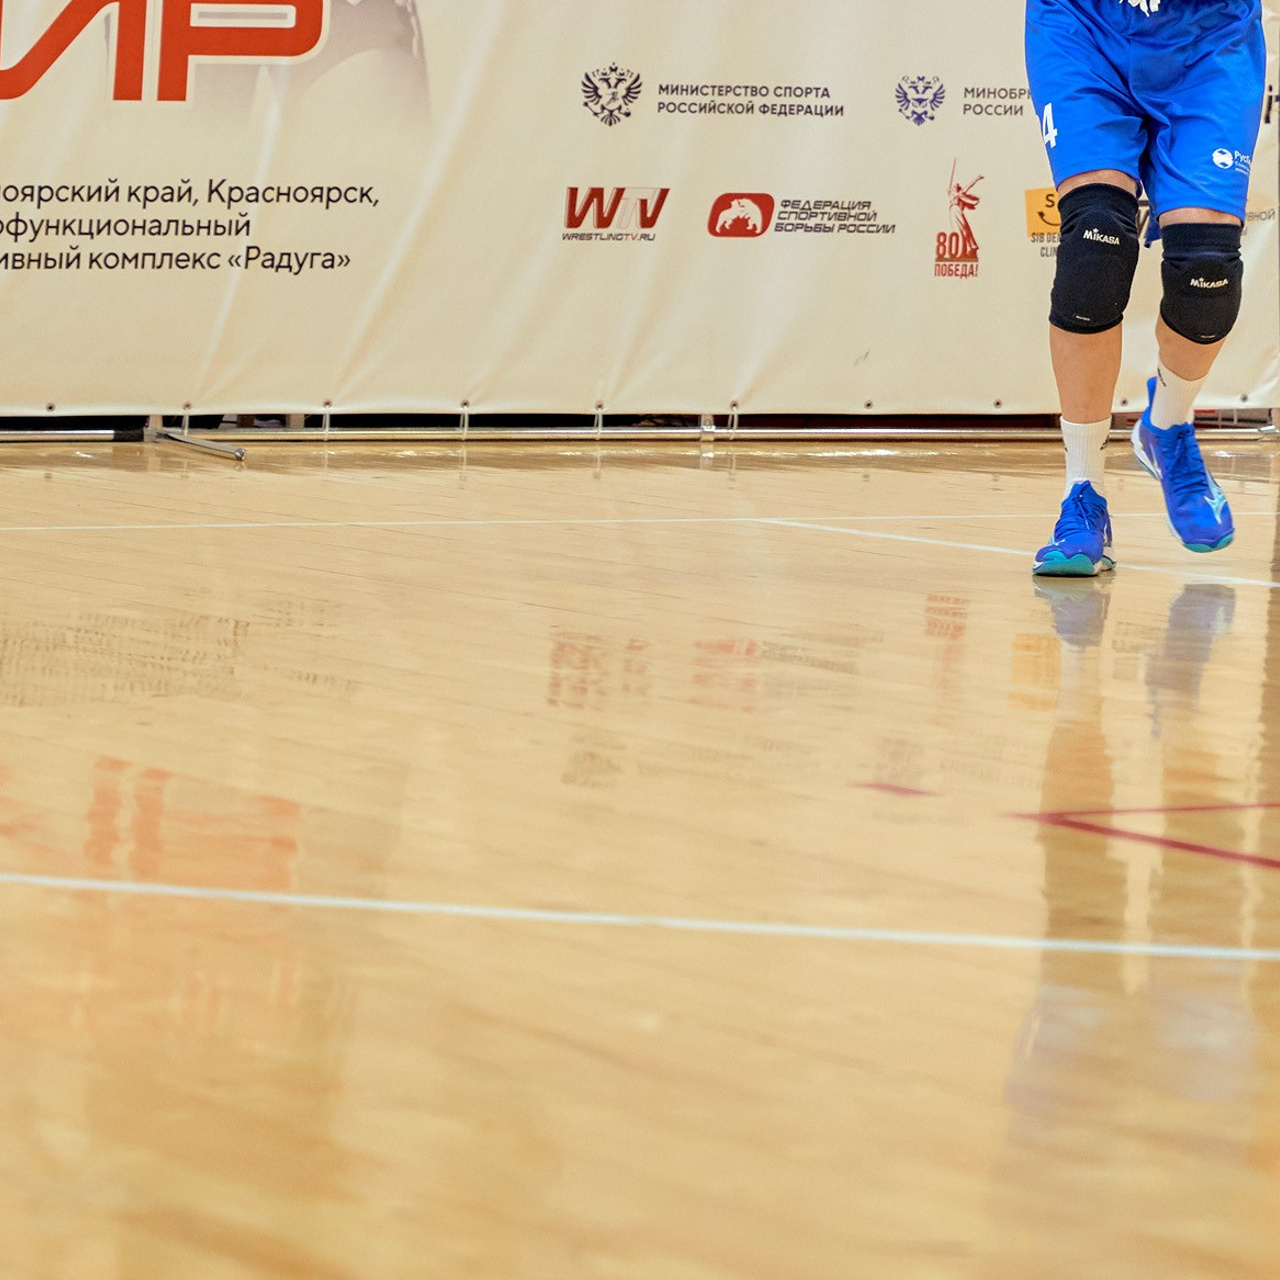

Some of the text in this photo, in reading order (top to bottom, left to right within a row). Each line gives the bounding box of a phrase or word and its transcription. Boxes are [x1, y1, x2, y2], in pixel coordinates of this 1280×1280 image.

[658, 83, 831, 100] МИНИСТЕРСТВО СПОРТА
[963, 86, 1031, 100] МИНОБР
[656, 100, 845, 118] РОССИЙСКОЙ ФЕДЕРАЦИИ
[962, 103, 1024, 116] РОССИИ
[1037, 102, 1058, 149] 4
[0, 177, 380, 210] оярский край, Красноярск,
[780, 200, 872, 211] ФЕДЕРАЦИЯ
[777, 210, 878, 222] СПОРТИВНОЙ
[773, 222, 896, 234] БОРЬБЫ РОССИИ
[561, 232, 657, 241] WRESTLINGTV.RU
[1031, 231, 1044, 243] SIB
[935, 231, 959, 259] 80
[88, 250, 222, 271] комплекс
[227, 245, 351, 276] «Радуга»
[934, 263, 979, 279] ПОБЕДА!
